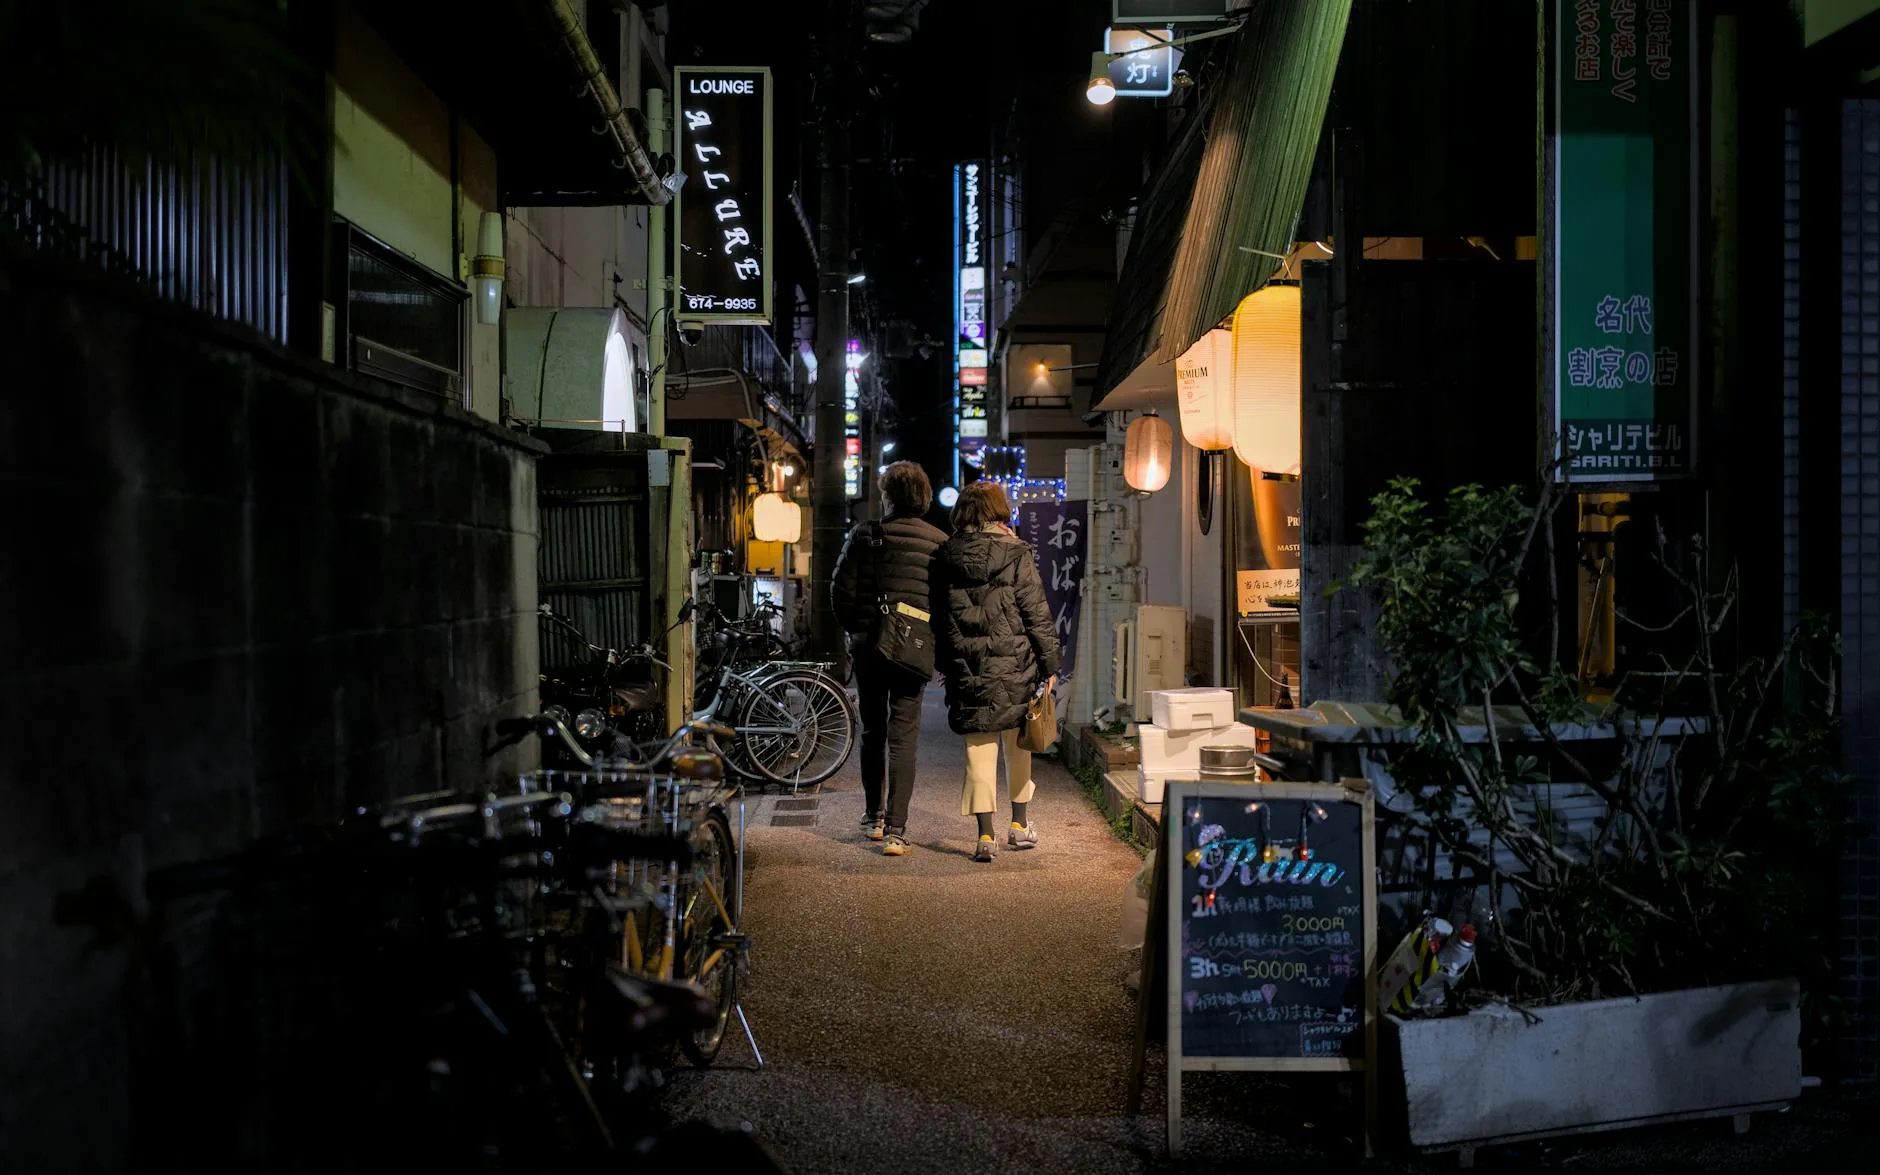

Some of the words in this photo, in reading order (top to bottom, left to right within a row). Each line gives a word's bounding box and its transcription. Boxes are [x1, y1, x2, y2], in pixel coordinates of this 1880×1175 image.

[690, 79, 754, 94] LOUNGE
[684, 110, 761, 281] ALLURE
[688, 298, 757, 309] 674-9935
[1596, 295, 1653, 334] 名代
[1568, 346, 1679, 389] 割烹の店
[1568, 424, 1682, 451] シャリテビル
[1287, 516, 1300, 527] PR
[1048, 514, 1081, 657] おばん
[1281, 914, 1345, 936] 3000円
[1190, 956, 1220, 980] 3h
[1243, 958, 1309, 982] 5000円
